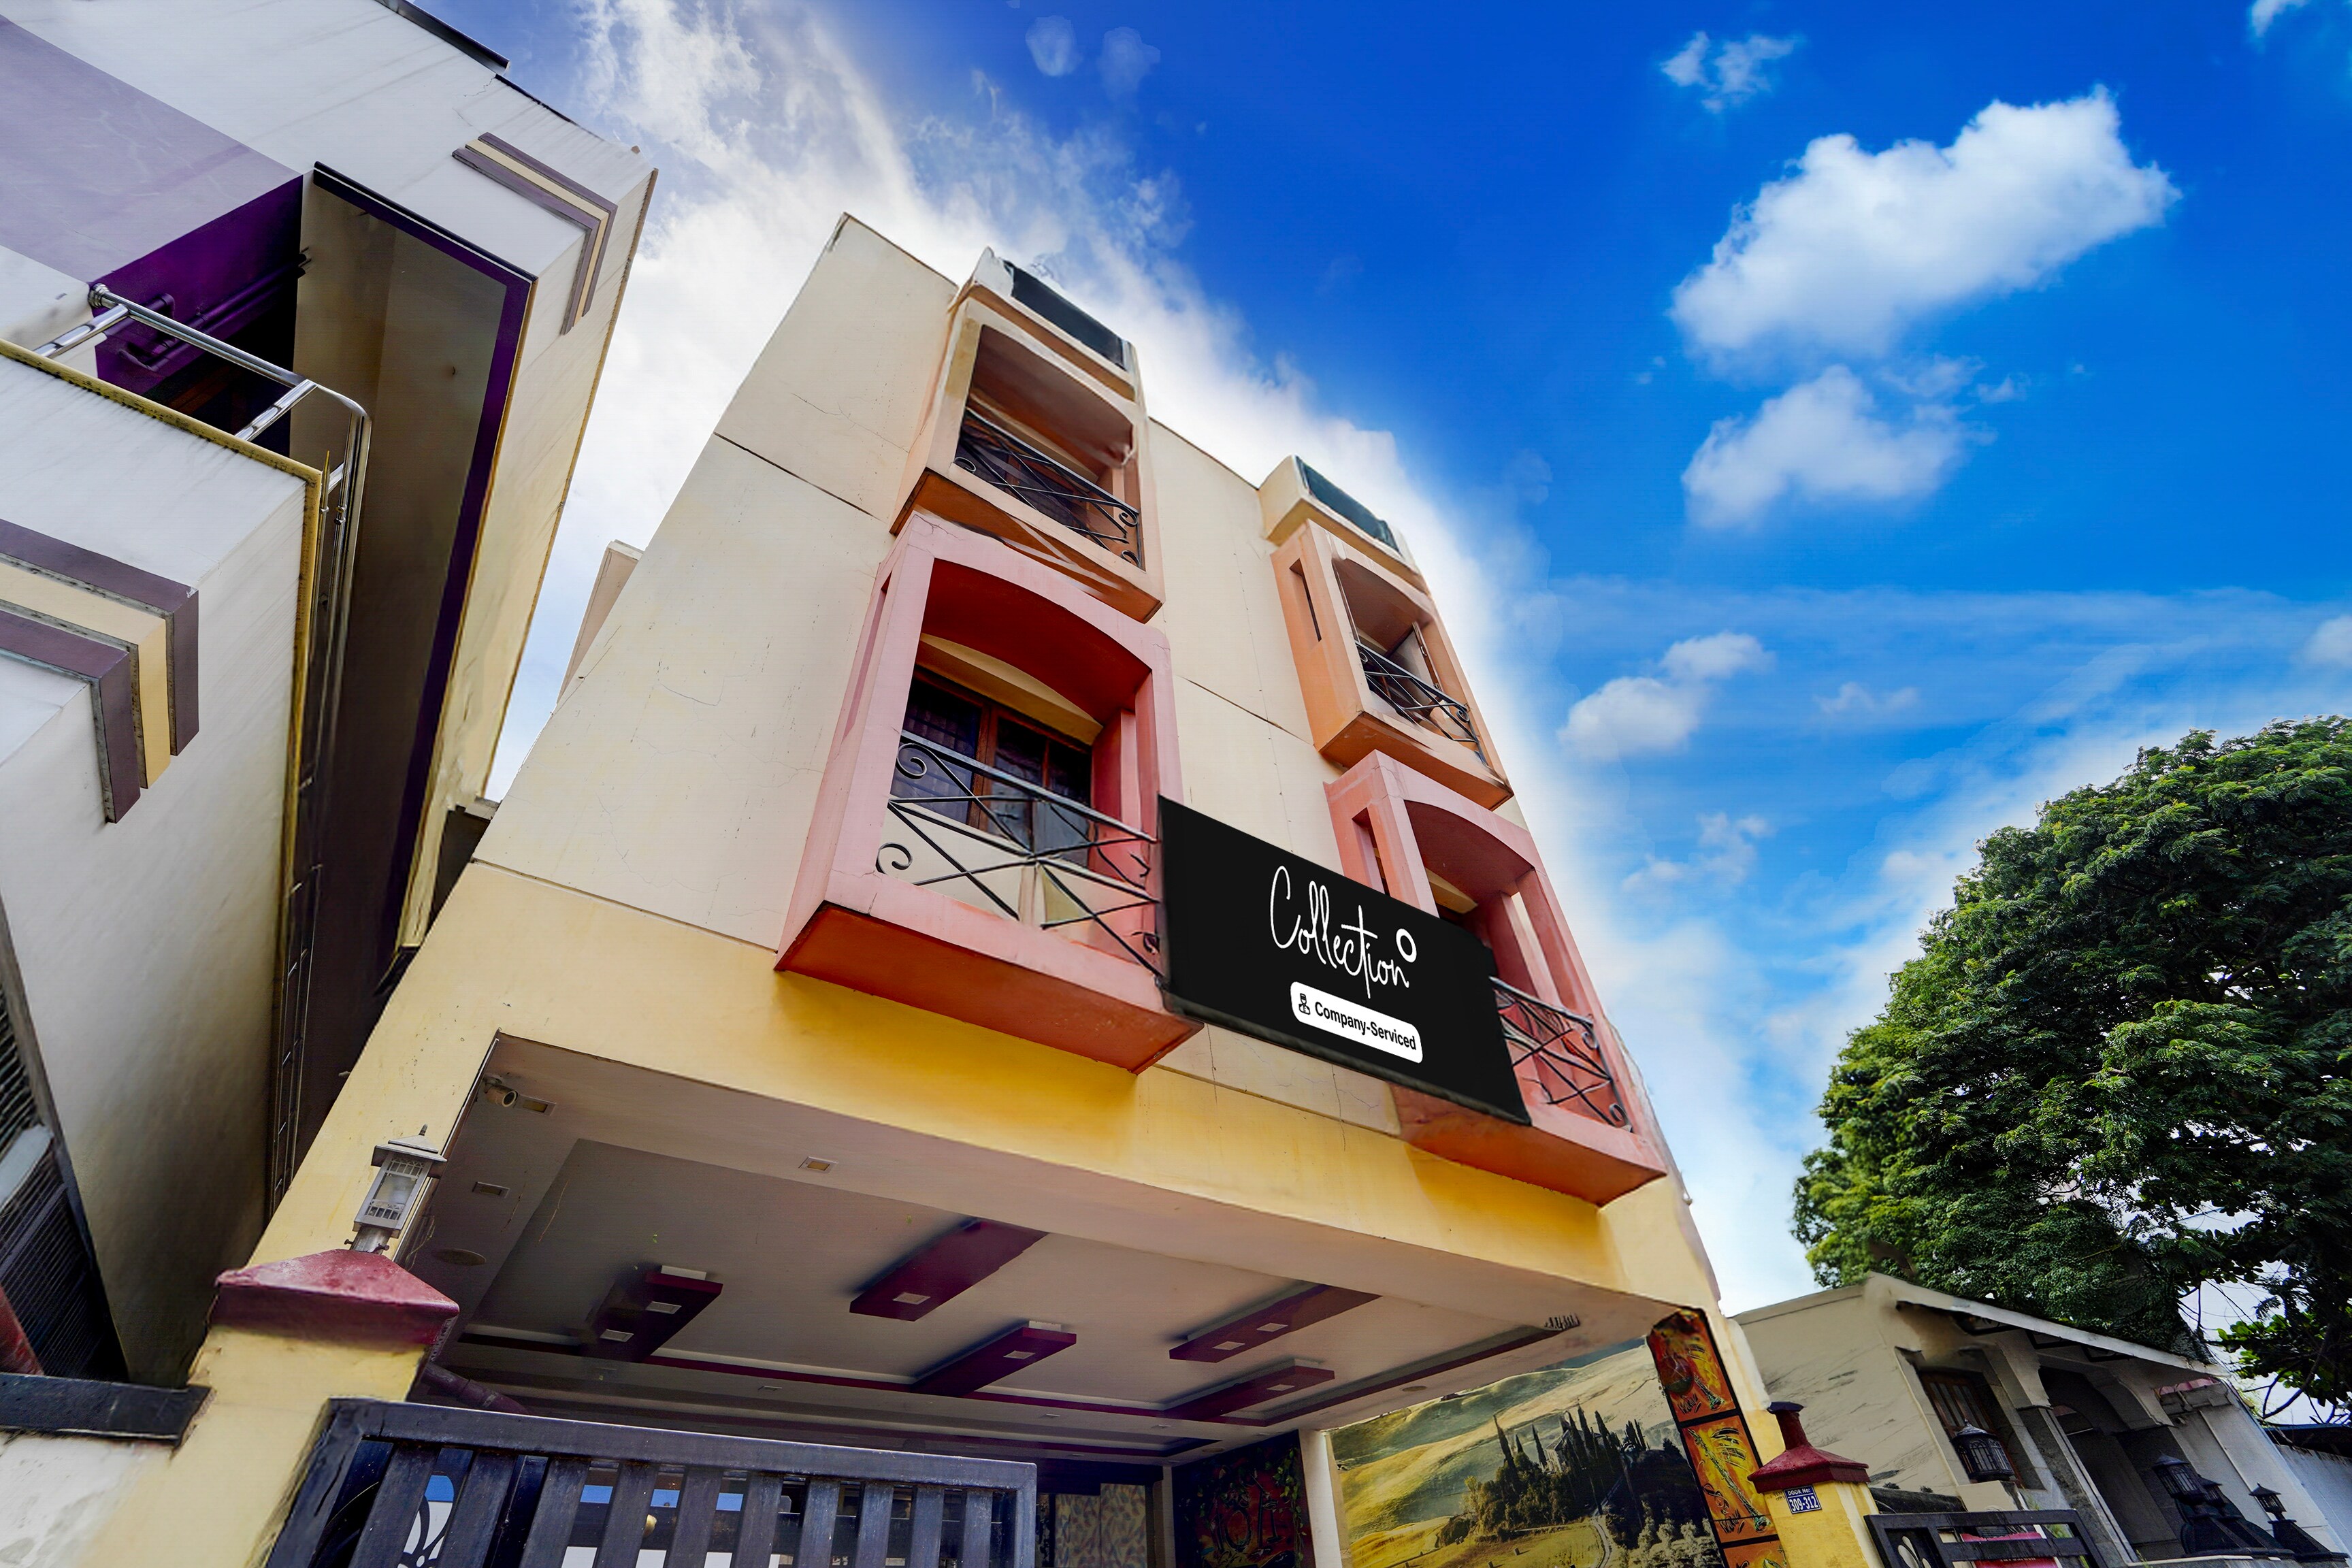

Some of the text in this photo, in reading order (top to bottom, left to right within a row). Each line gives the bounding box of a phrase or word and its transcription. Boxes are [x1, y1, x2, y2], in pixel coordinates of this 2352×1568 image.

[1270, 865, 1409, 999] Collection
[1314, 1001, 1417, 1050] Company-Serviced
[1789, 1495, 1819, 1512] 309-312
